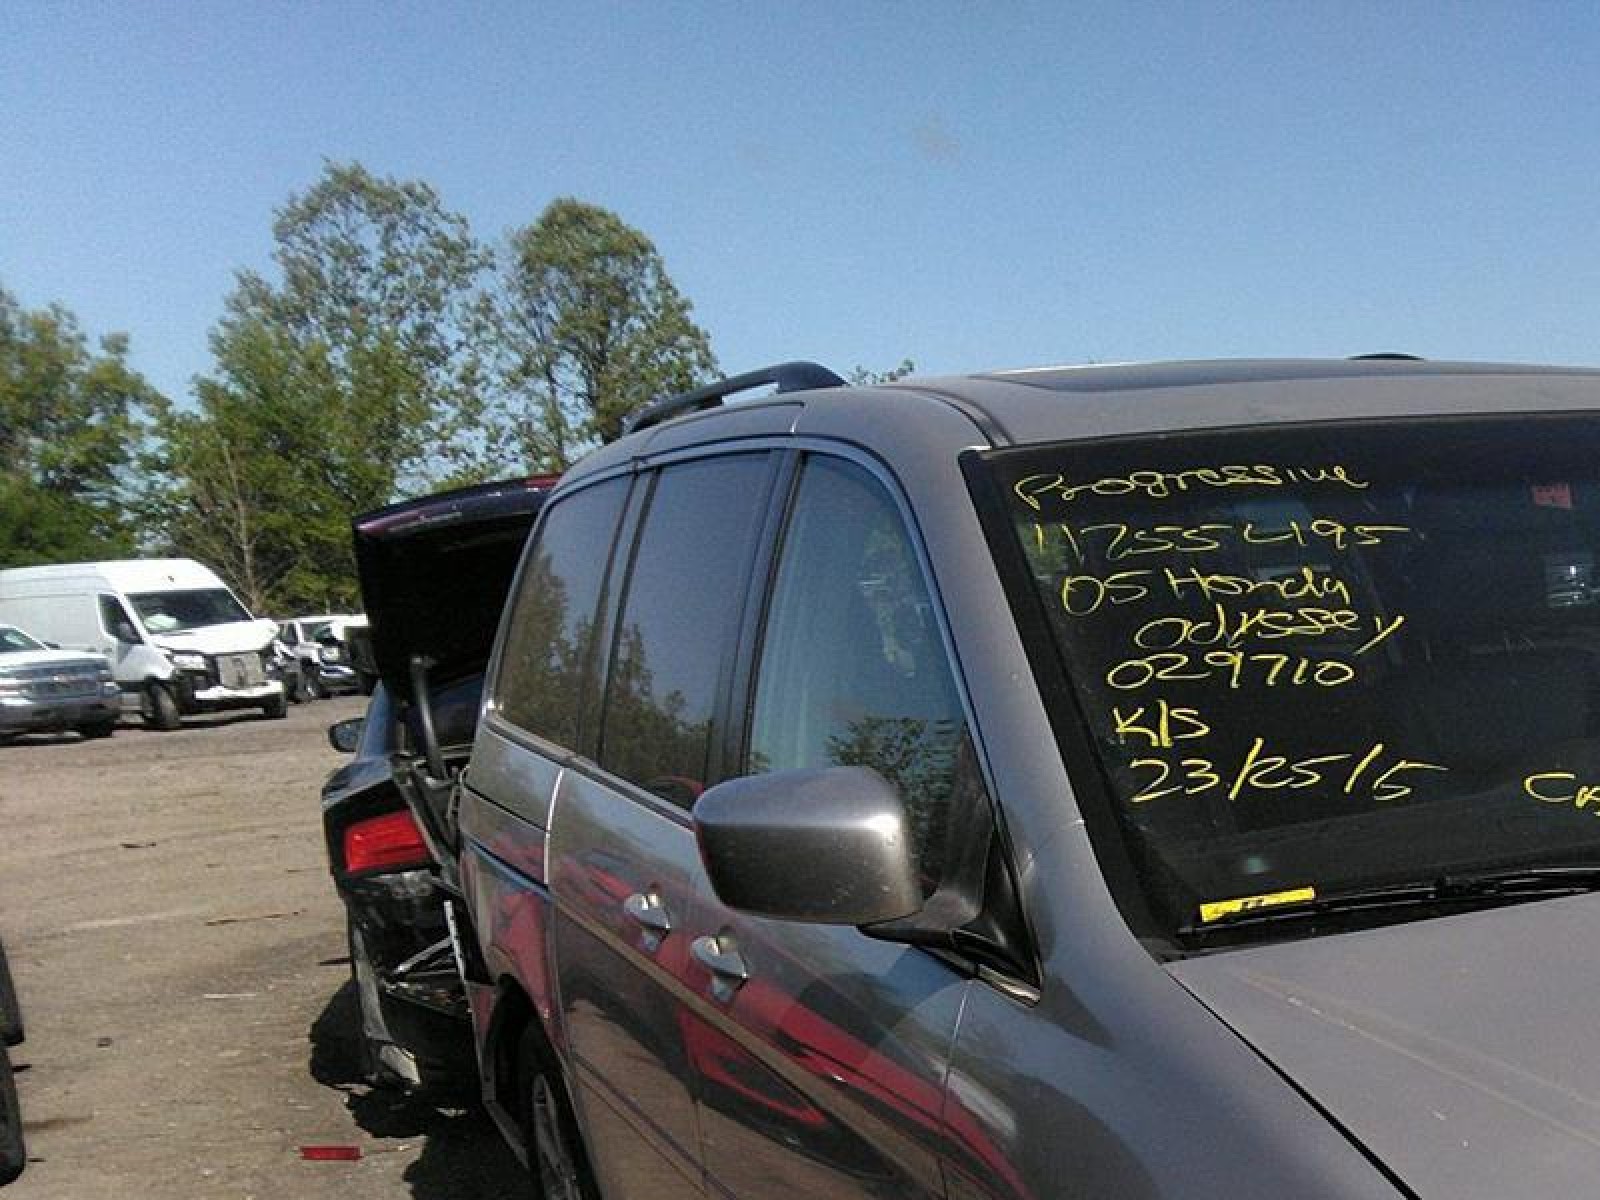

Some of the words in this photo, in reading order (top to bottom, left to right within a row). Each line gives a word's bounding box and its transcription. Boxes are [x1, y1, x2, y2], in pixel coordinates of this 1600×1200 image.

[1061, 569, 1154, 616] 05
[1163, 566, 1352, 605] Honda
[1107, 651, 1355, 689] 029710
